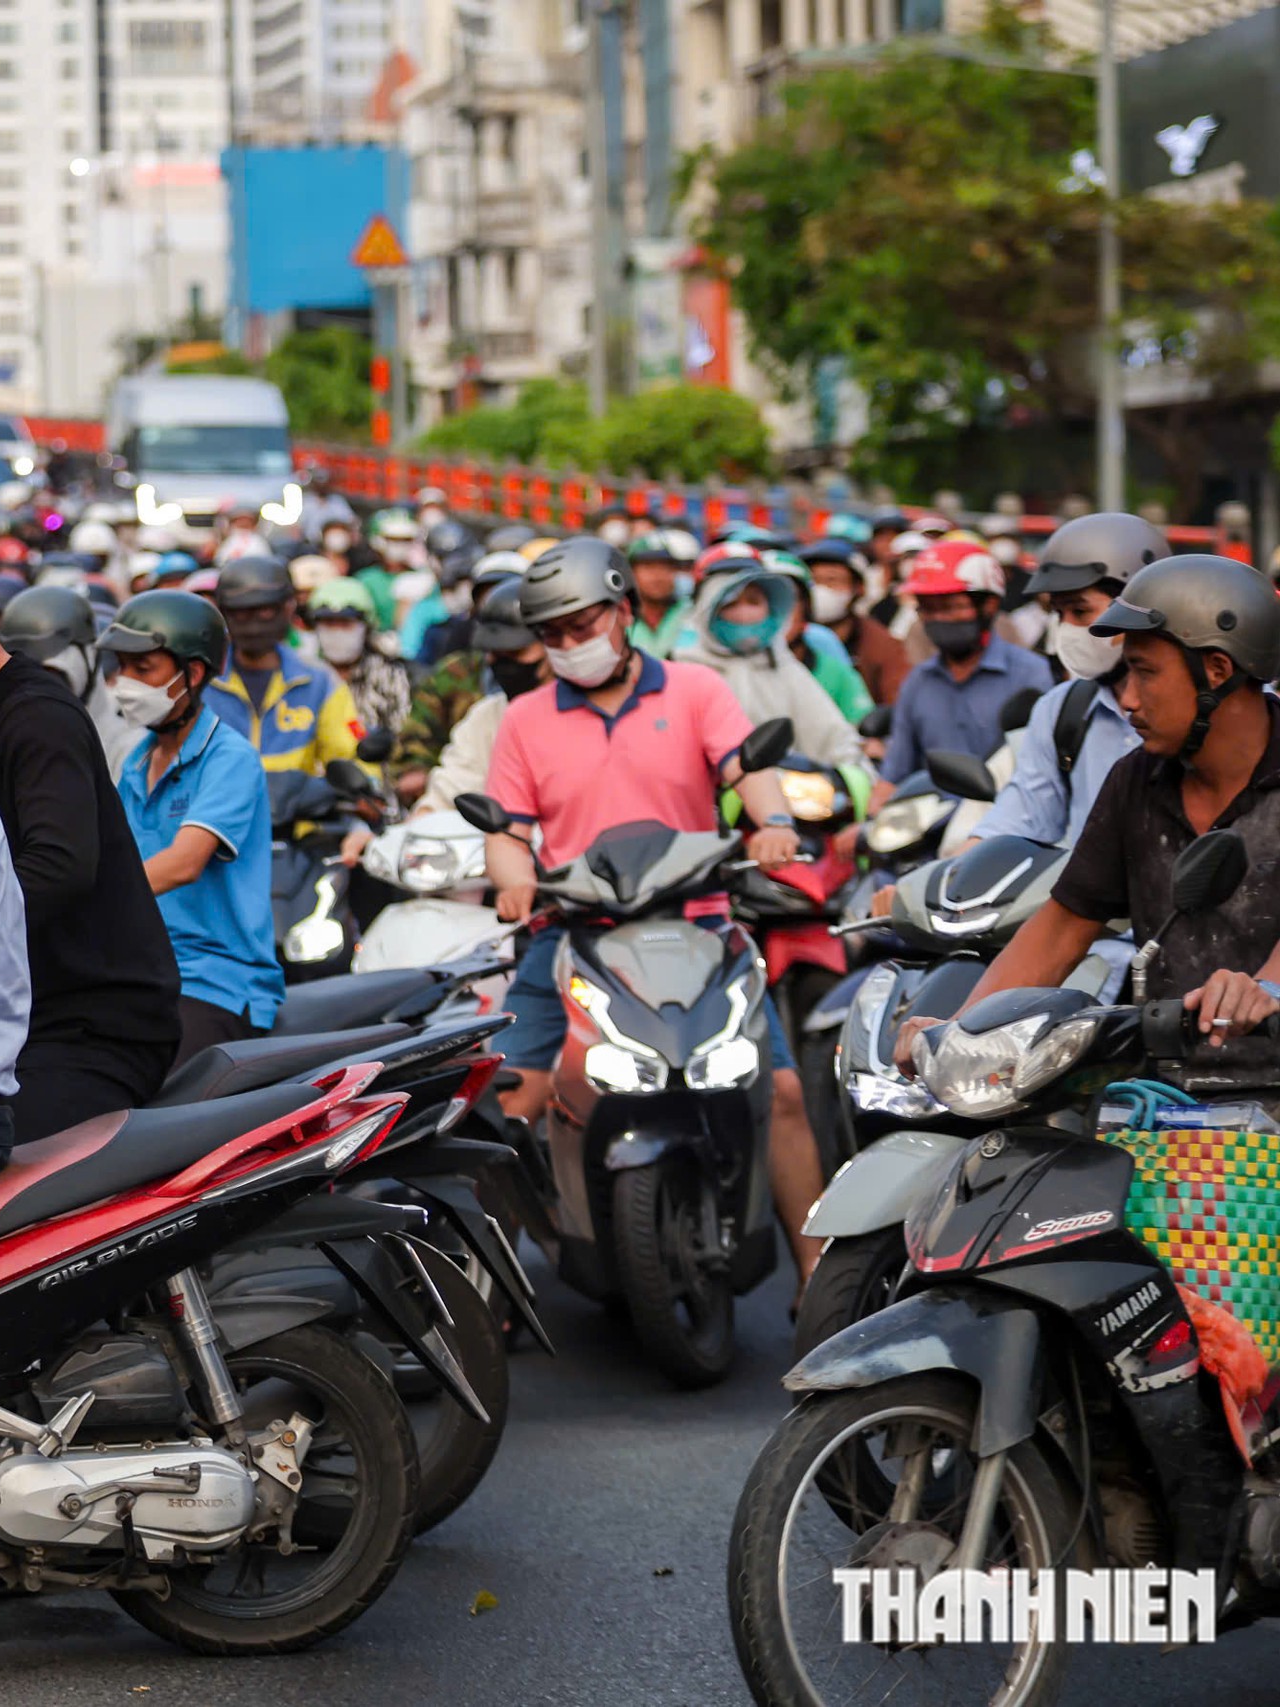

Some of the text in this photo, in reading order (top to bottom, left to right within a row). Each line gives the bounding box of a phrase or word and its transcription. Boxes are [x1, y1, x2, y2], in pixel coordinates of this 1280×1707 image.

[276, 700, 314, 732] be
[38, 1212, 199, 1292] AIR BLADE
[1094, 1281, 1163, 1336] YAMAHA
[167, 1497, 237, 1509] HONDA
